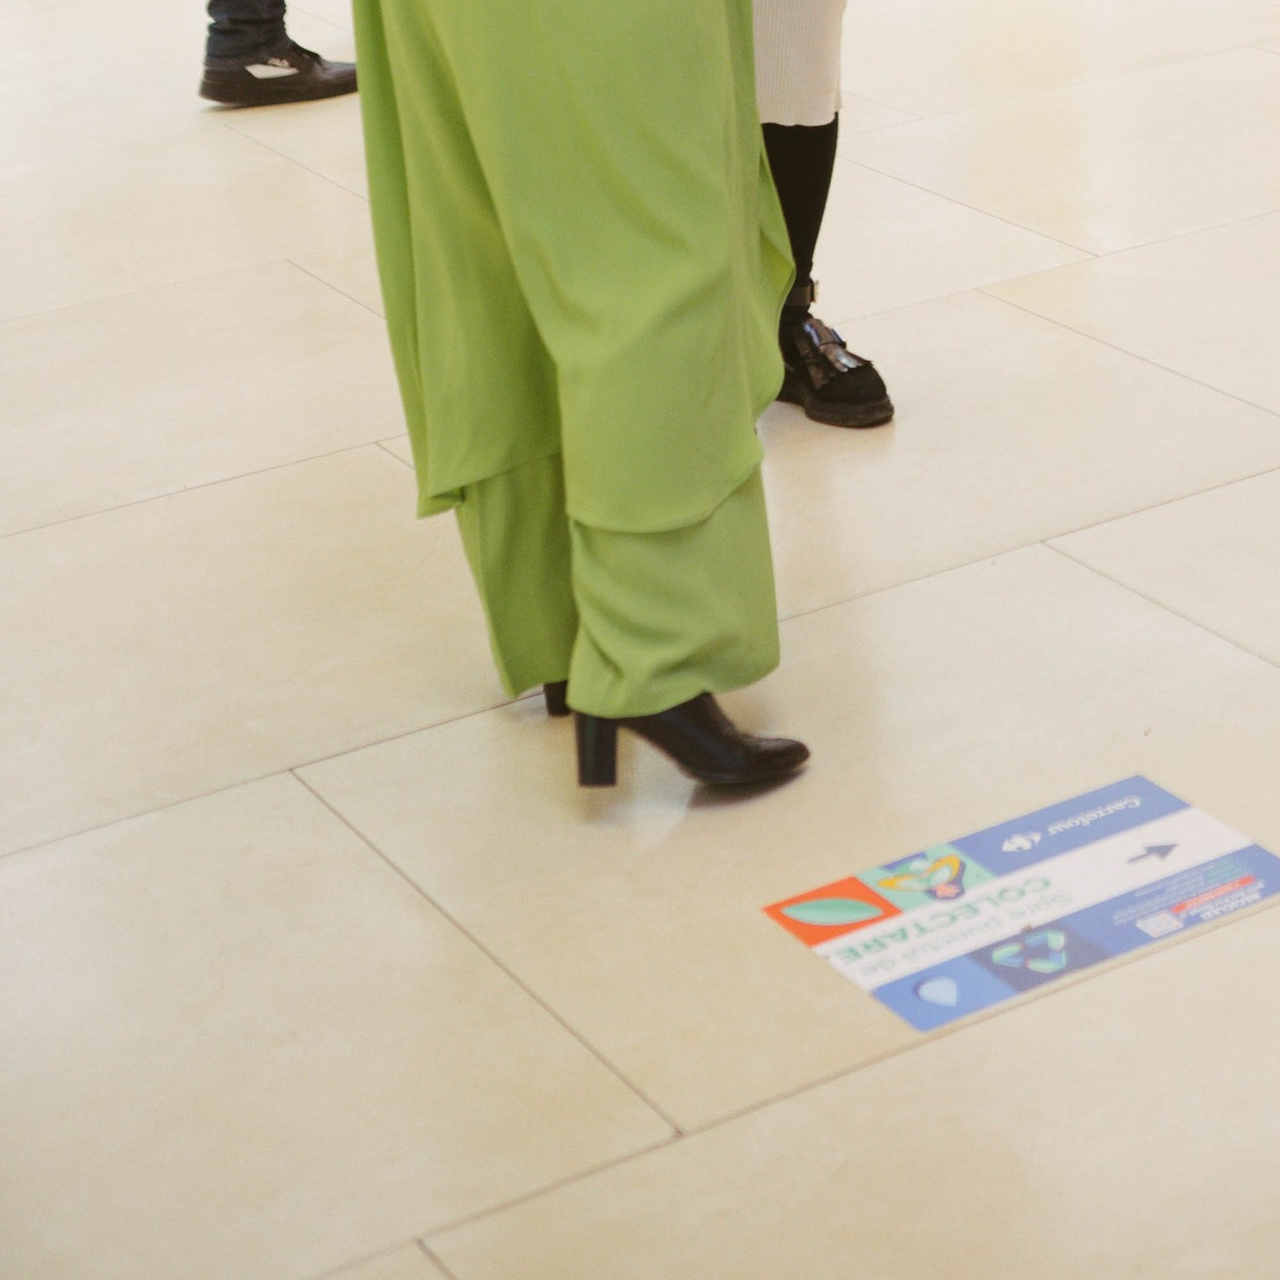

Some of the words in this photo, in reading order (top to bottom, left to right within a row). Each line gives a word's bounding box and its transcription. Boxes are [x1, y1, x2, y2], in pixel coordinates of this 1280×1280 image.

[1045, 794, 1143, 837] Carrefour
[833, 876, 1054, 966] COLECTARE
[1004, 889, 1078, 923] Spre
[900, 915, 1007, 965] punctul
[858, 957, 900, 979] de
